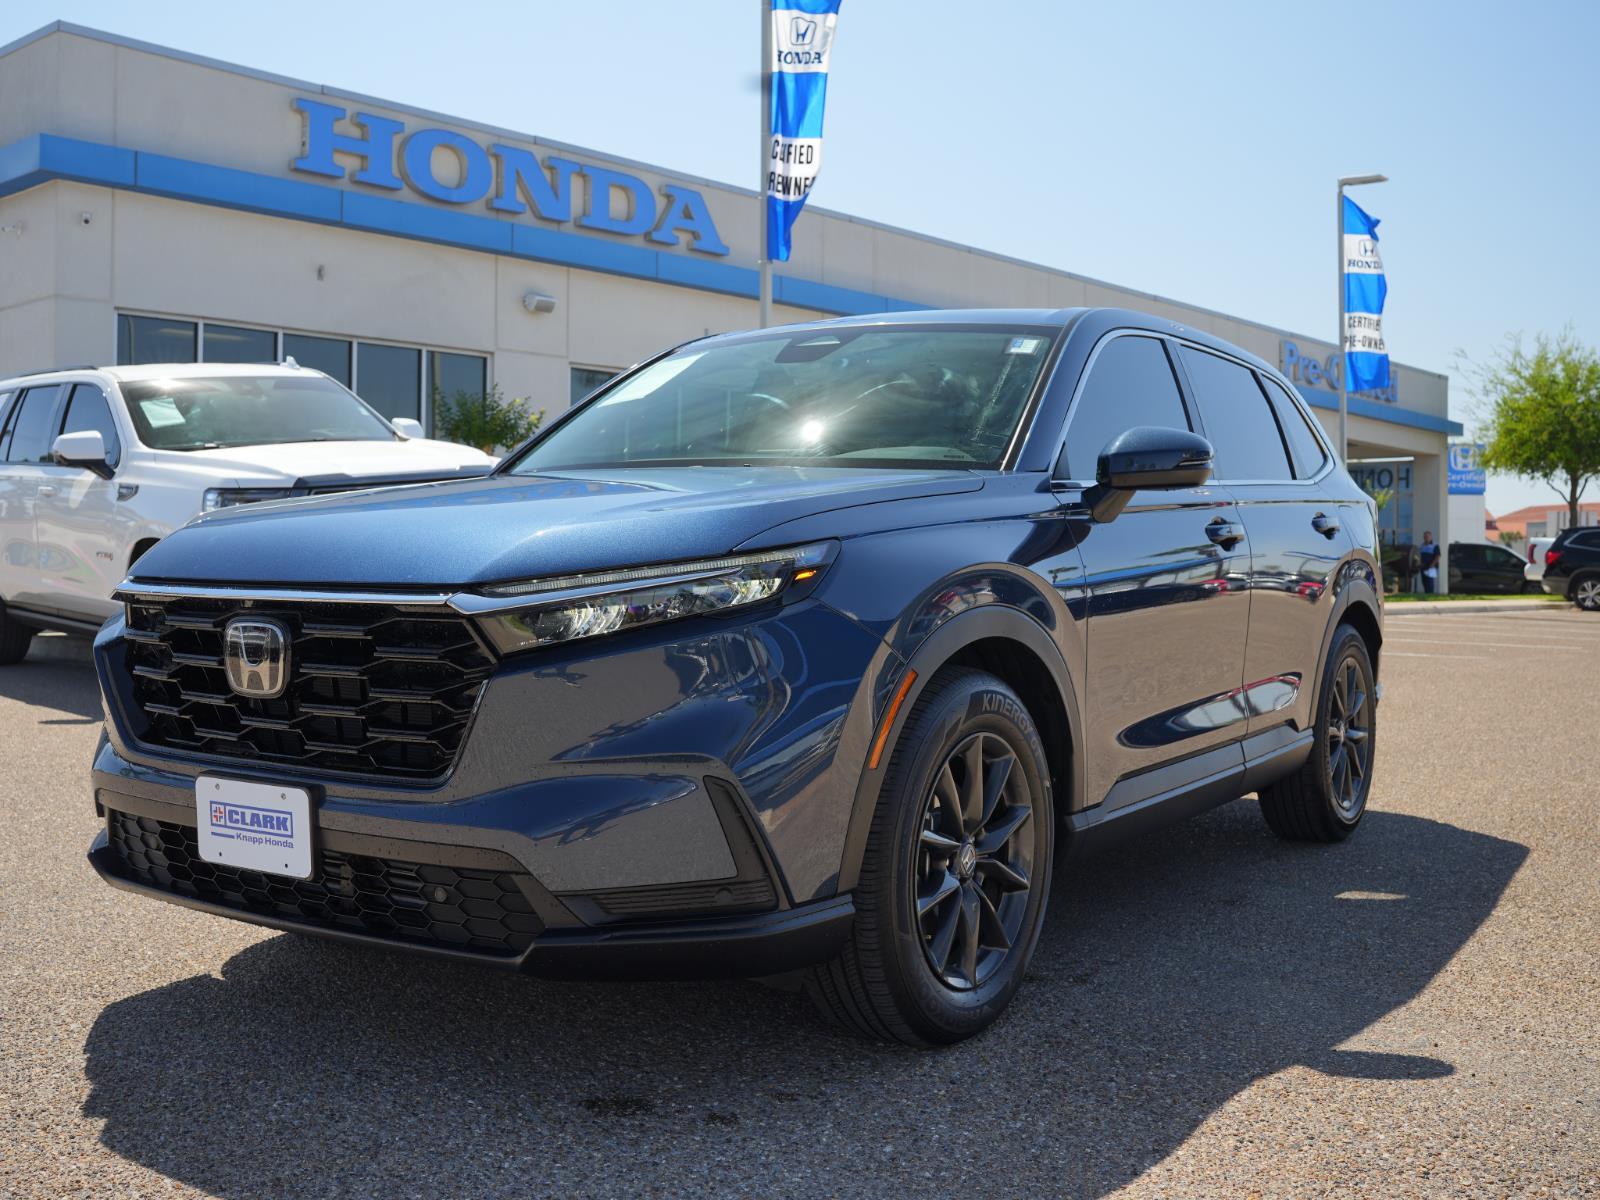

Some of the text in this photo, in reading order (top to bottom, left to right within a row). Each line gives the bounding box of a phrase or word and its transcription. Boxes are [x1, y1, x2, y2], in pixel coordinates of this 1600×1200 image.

[291, 97, 730, 257] HONDA
[982, 692, 1033, 735] KINERGY
[227, 808, 289, 832] CLARK
[235, 832, 294, 849] Knapp Honda
